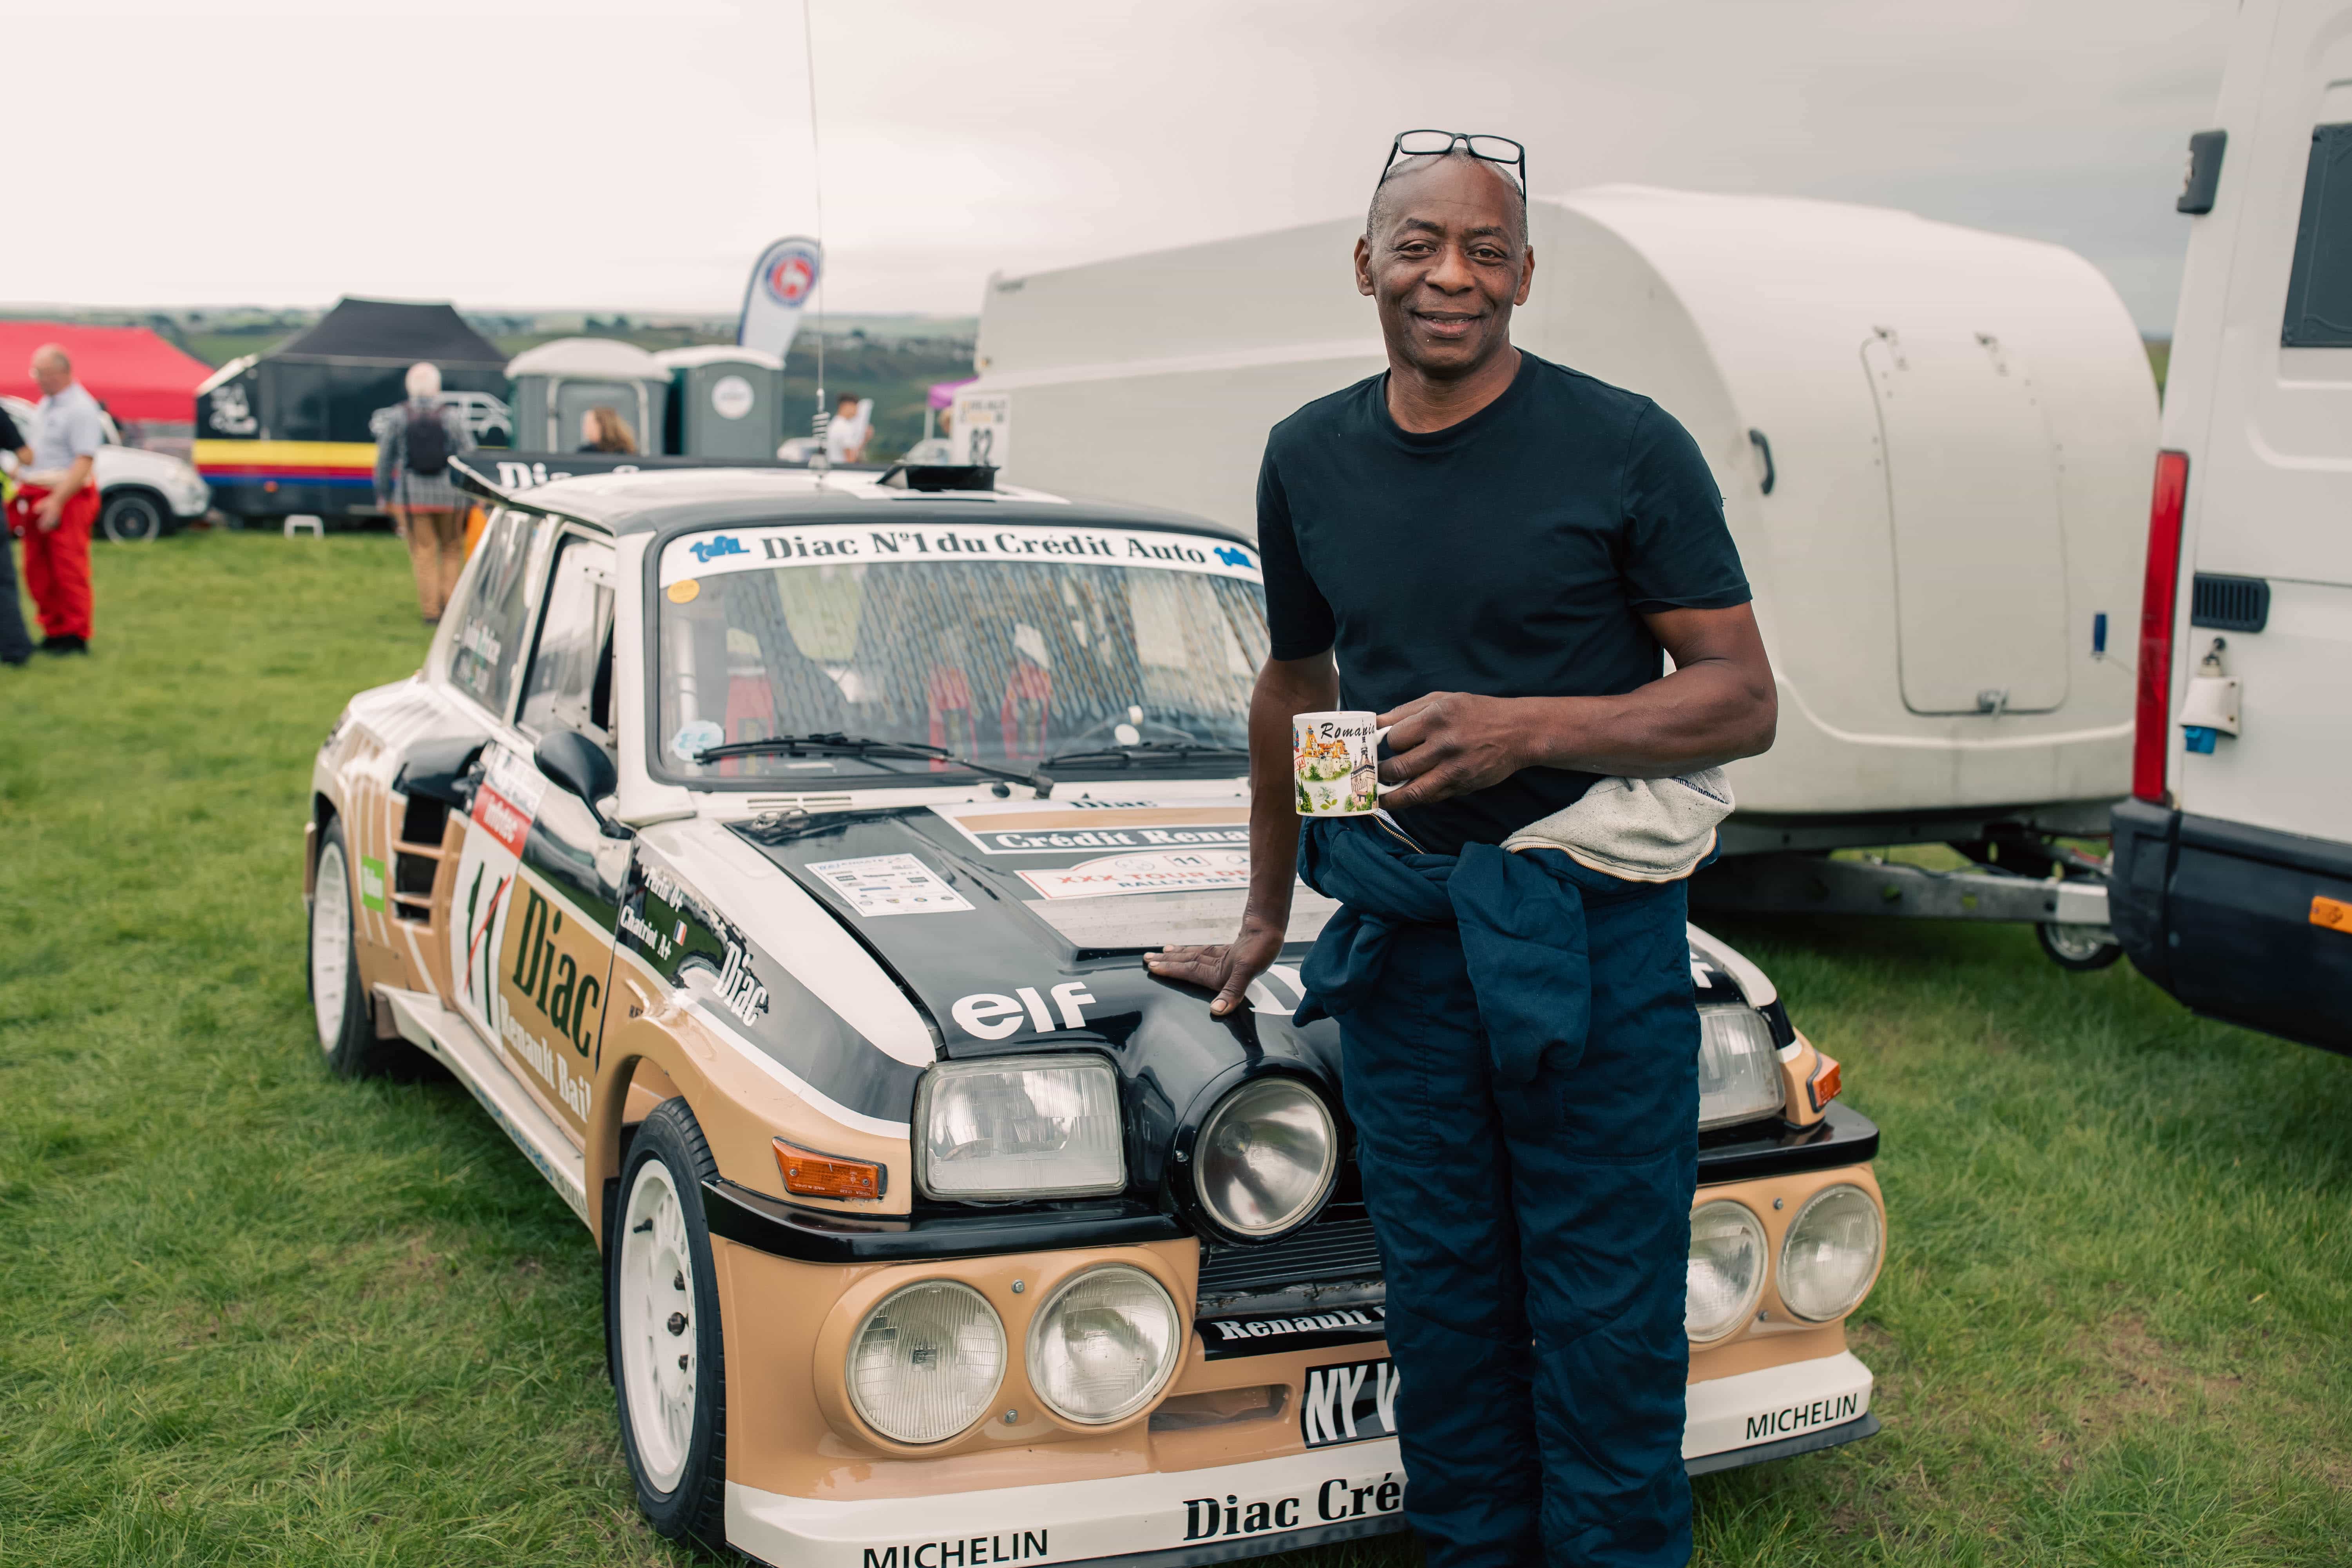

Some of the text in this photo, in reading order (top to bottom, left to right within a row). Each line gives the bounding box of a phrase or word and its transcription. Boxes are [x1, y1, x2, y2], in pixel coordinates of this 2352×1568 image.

[761, 537, 859, 559] Diac
[937, 532, 990, 553] du
[994, 533, 1115, 556] Crédit
[1126, 537, 1207, 564] Auto
[1320, 722, 1376, 739] Romania
[995, 828, 1249, 848] Crédit Rena
[1055, 874, 1120, 883] XXX
[1124, 872, 1206, 880] TOUR
[1117, 879, 1202, 888] RALLYE
[619, 905, 658, 950] Chatriot
[512, 887, 601, 1057] Diac
[713, 940, 768, 1027] Diac
[951, 981, 1097, 1040] elf
[1215, 1309, 1371, 1340] Renault
[1746, 1392, 1858, 1440] MICHELIN
[1183, 1494, 1300, 1541] Diac
[863, 1529, 1048, 1568] MICHELIN
